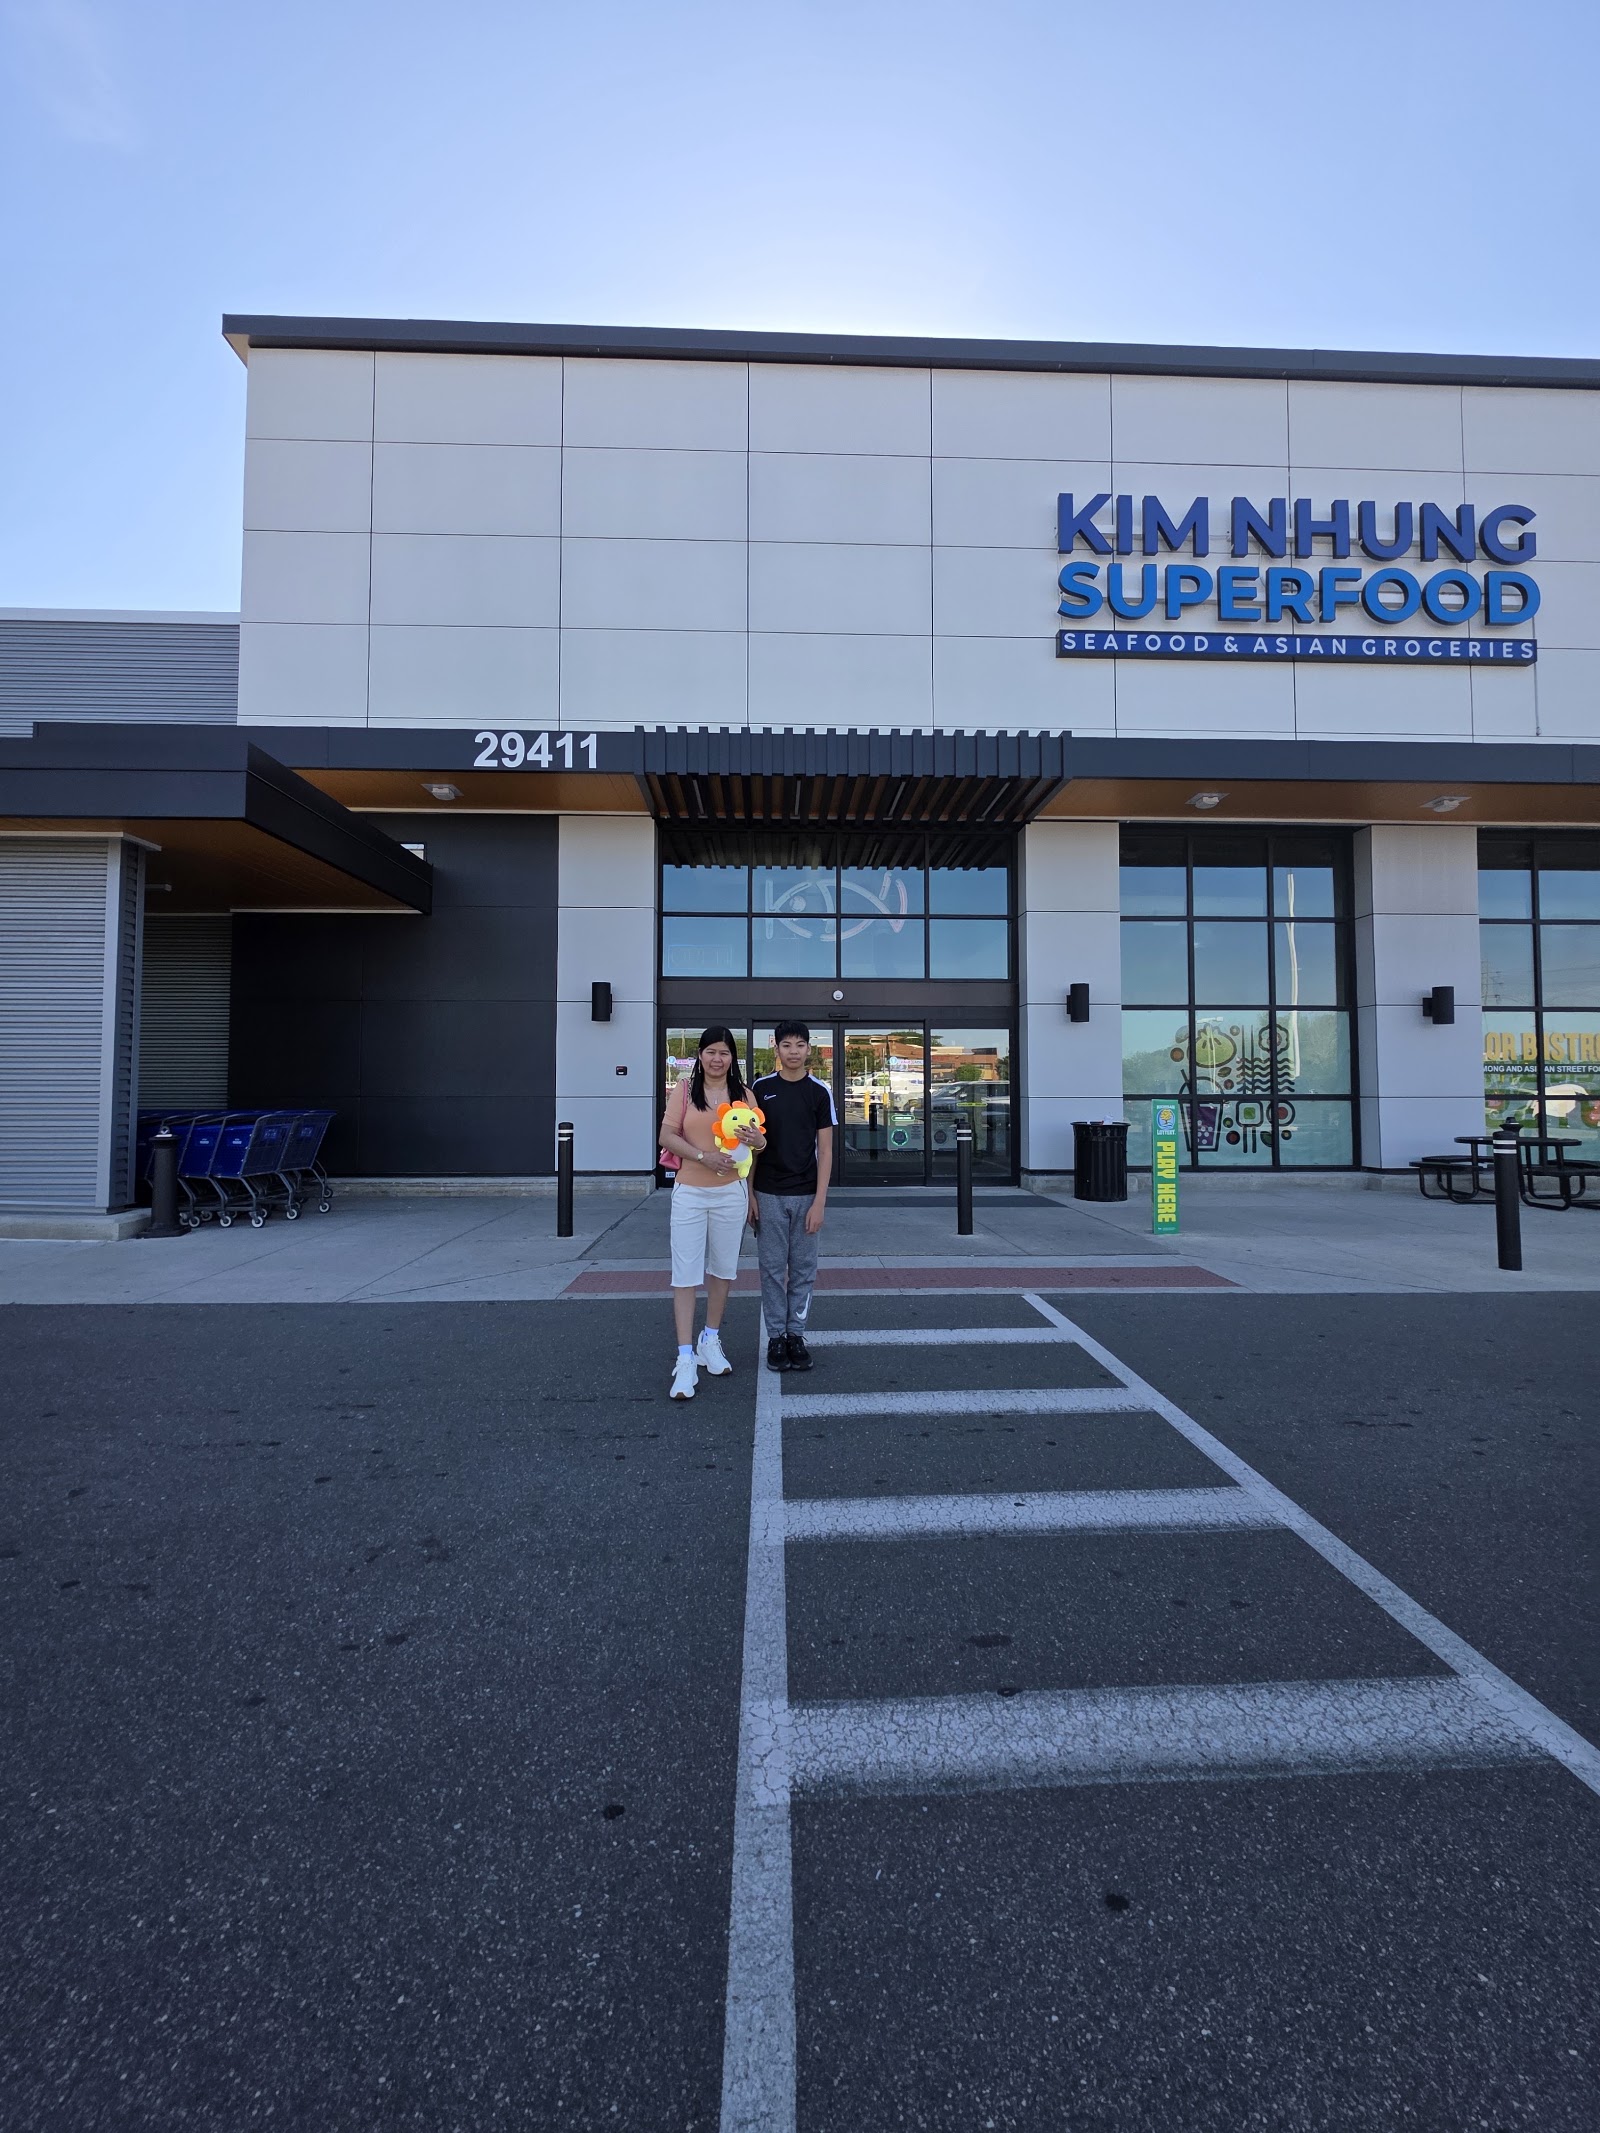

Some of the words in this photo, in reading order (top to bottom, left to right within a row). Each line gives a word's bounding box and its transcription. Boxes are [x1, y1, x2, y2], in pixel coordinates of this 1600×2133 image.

[1057, 493, 1209, 558] KIM
[1231, 496, 1537, 565] NHUNG
[1057, 561, 1541, 627] SUPERFOOD
[1063, 632, 1209, 653] SEAFOOD
[1223, 636, 1239, 653] &
[1253, 637, 1348, 656] ASIAN
[1362, 639, 1535, 660] GROCERIES
[473, 731, 597, 769] 29411
[1521, 1032, 1600, 1061] BISTR
[1506, 1065, 1523, 1073] AND
[1524, 1065, 1555, 1073] ASIAN
[1557, 1065, 1587, 1073] STREET
[1157, 1142, 1176, 1179] PLAY
[1157, 1183, 1176, 1223] HERE
